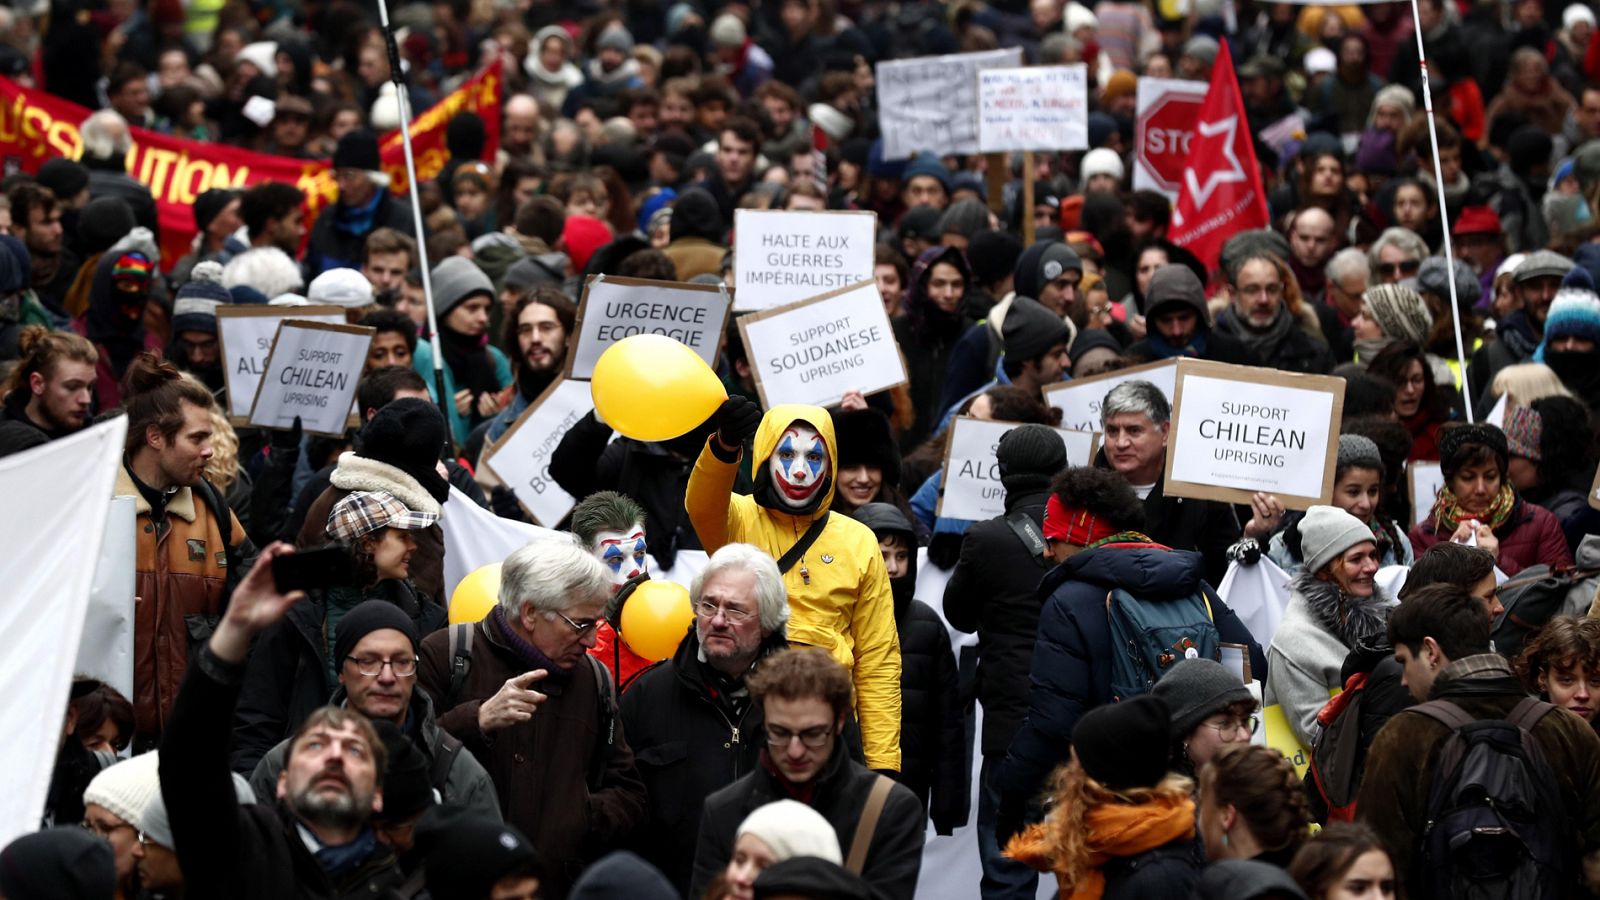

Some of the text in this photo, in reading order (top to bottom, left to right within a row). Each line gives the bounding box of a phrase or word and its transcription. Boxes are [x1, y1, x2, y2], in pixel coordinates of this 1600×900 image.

[762, 234, 849, 249] HALTE AUX
[767, 252, 844, 268] GUERRES
[605, 302, 707, 324] URGENCE
[790, 316, 851, 346] SUPPORT
[298, 348, 343, 364] SUPPORT
[770, 326, 882, 374] SOUDANESE
[280, 366, 348, 391] CHILEAN
[800, 353, 865, 384] UPRISING
[283, 391, 328, 408] UPRISING
[1221, 401, 1290, 421] SUPPORT
[532, 410, 578, 463] SUPPORT
[1199, 418, 1306, 450] CHILEAN
[1214, 448, 1285, 468] UPRISING
